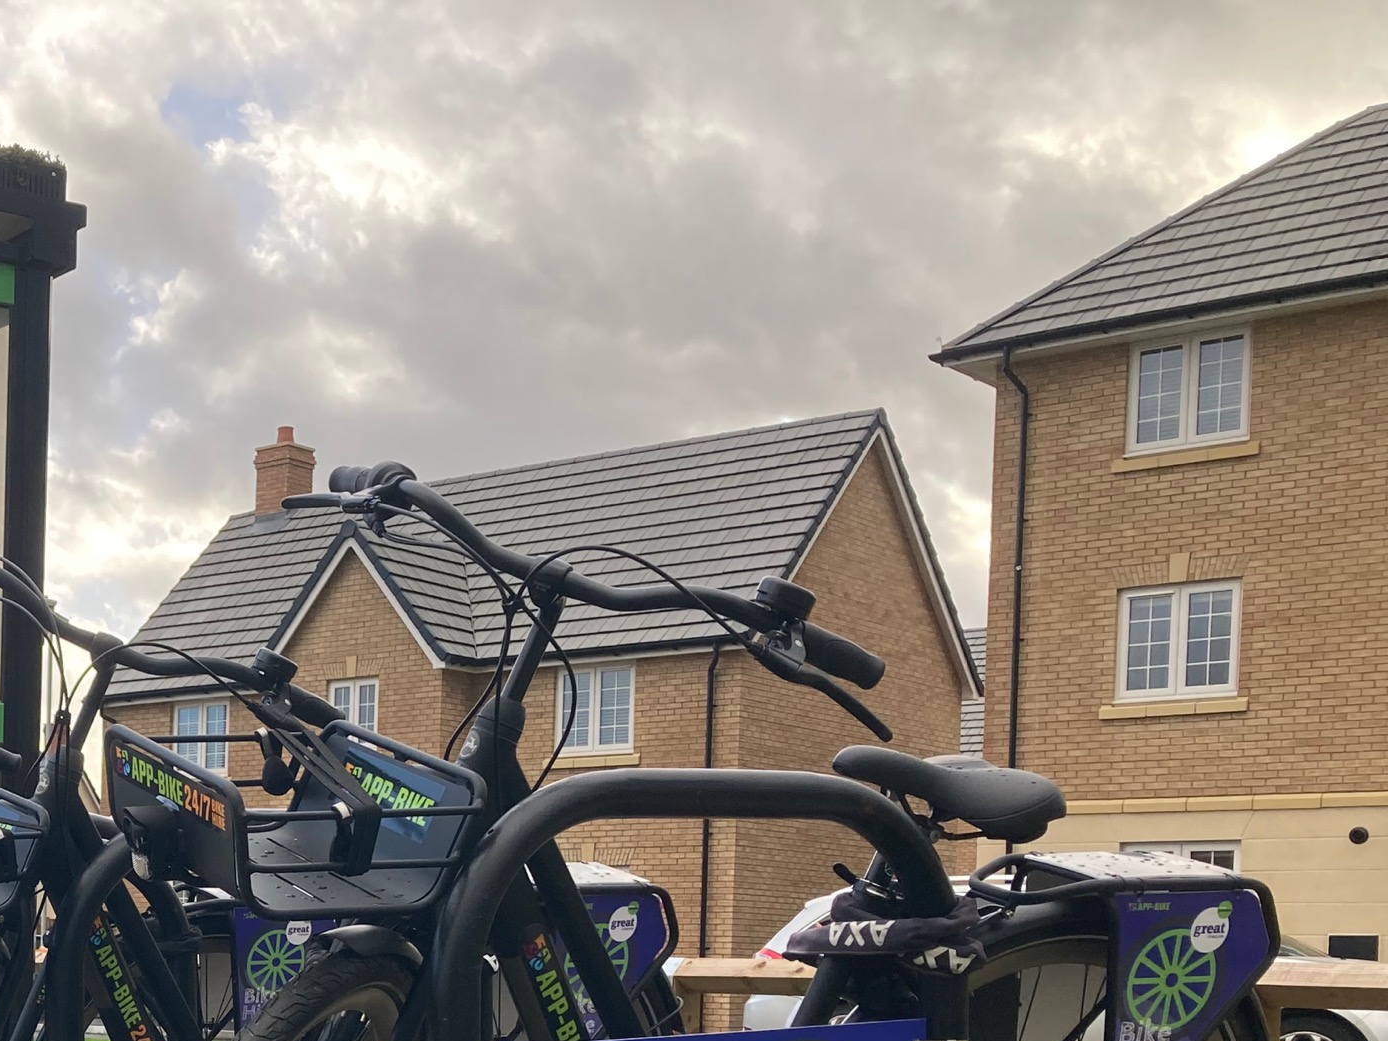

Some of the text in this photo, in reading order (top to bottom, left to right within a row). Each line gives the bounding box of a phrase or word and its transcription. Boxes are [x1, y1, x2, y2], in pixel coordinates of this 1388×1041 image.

[132, 756, 212, 822] APP-BIKE 24/7
[360, 772, 436, 827] APP-BIKE
[287, 925, 310, 936] great
[611, 918, 635, 931] great
[828, 920, 896, 947] AXA
[1193, 923, 1226, 938] great
[95, 943, 142, 1029] APP-BIKE
[535, 970, 581, 1041] APP-BI
